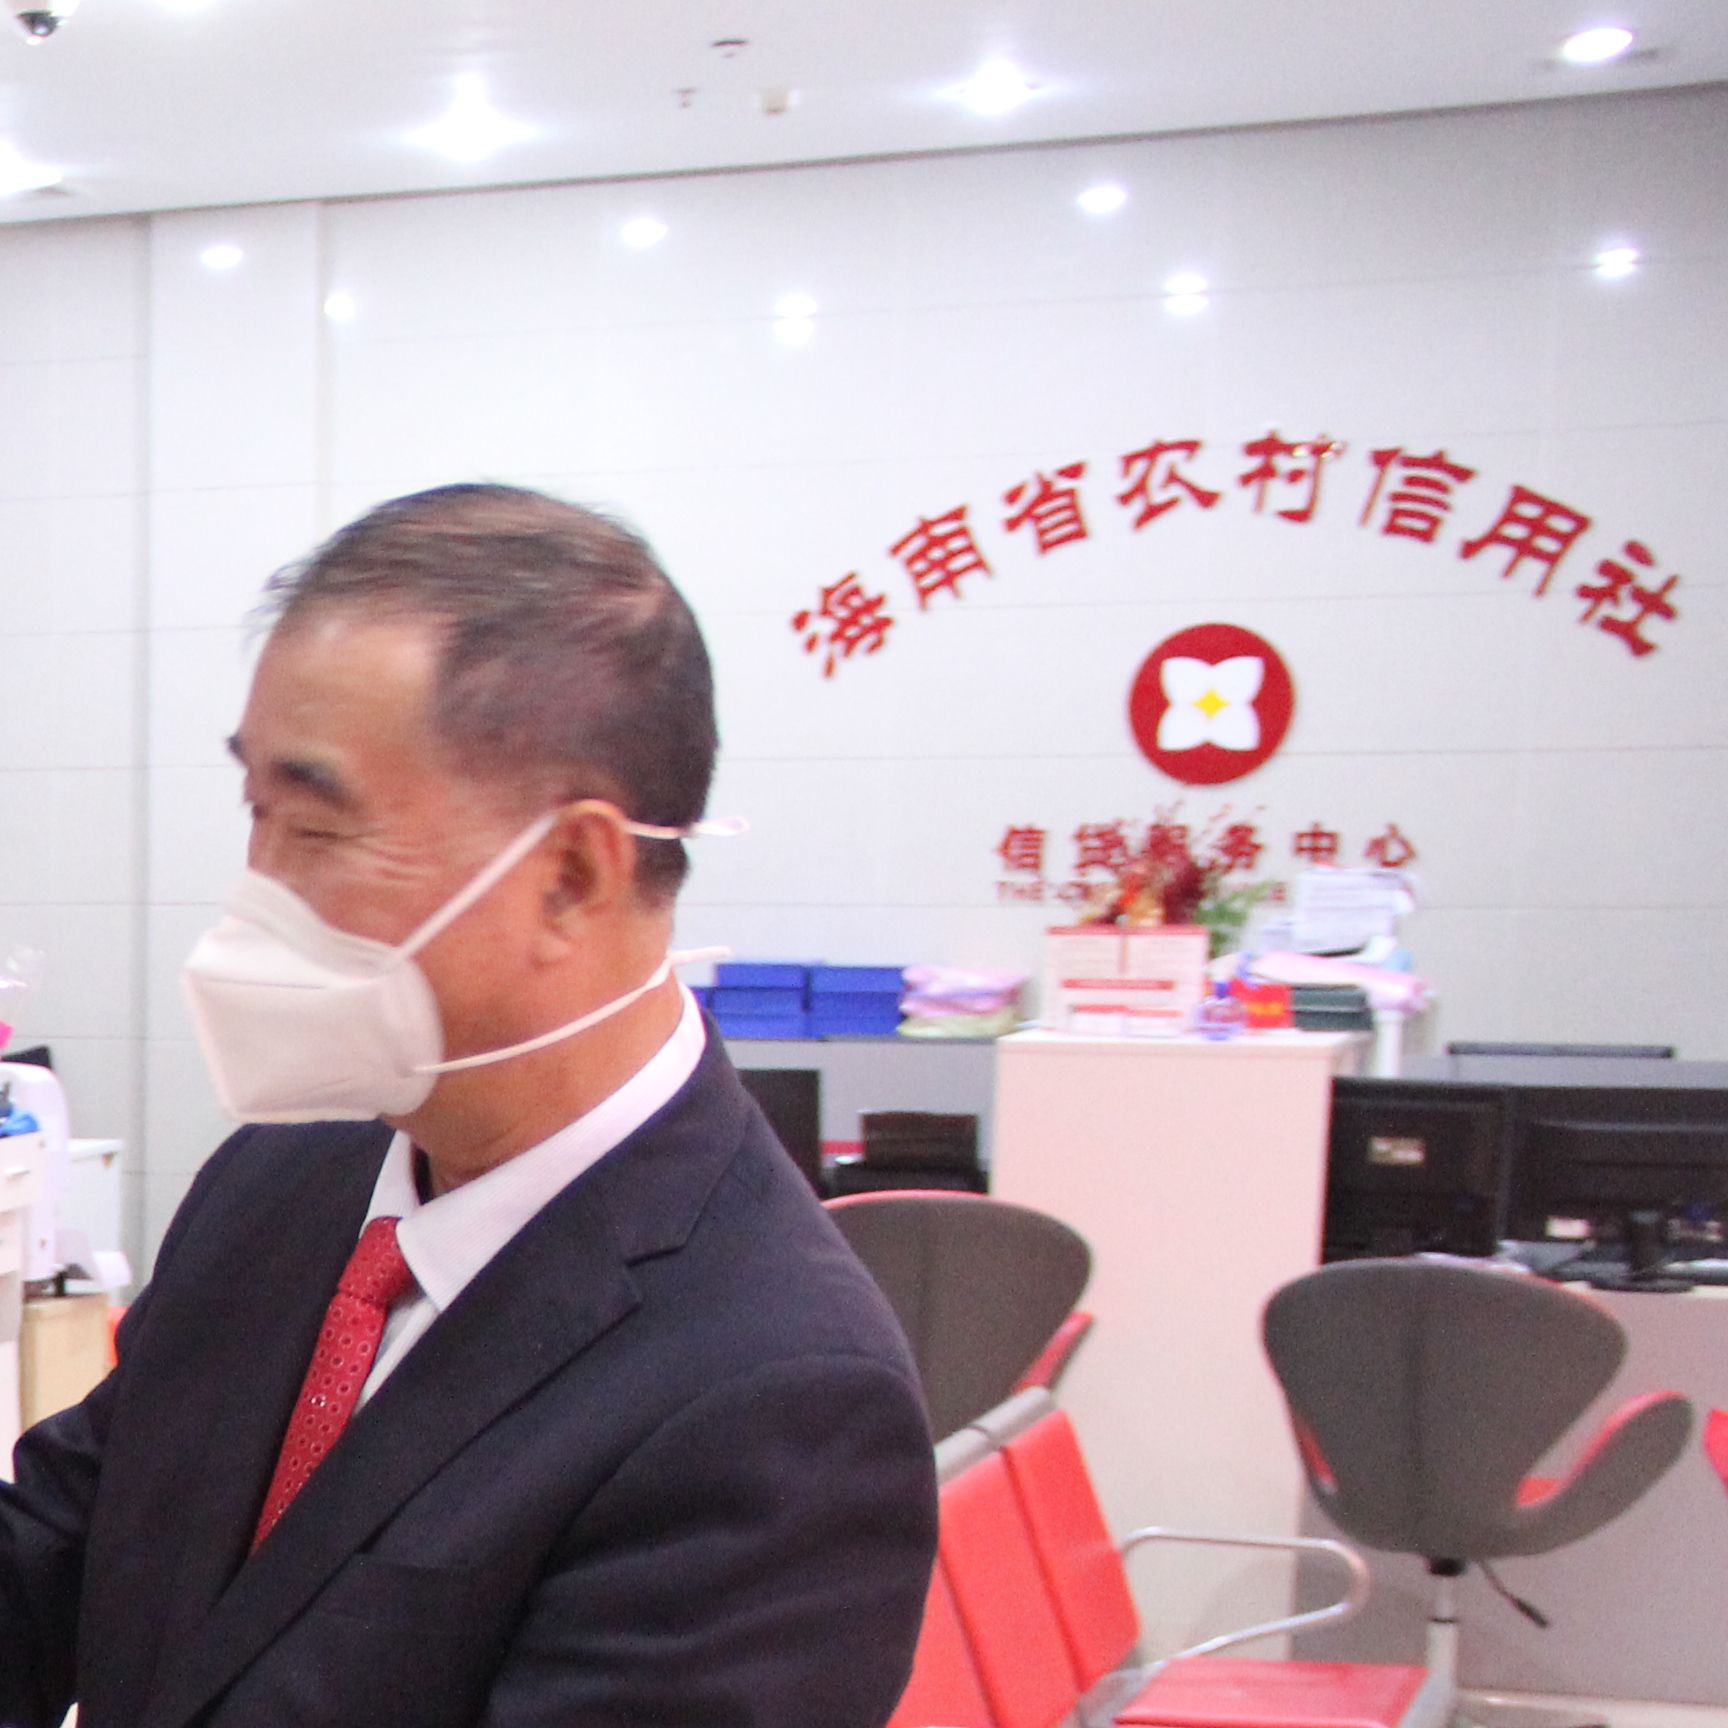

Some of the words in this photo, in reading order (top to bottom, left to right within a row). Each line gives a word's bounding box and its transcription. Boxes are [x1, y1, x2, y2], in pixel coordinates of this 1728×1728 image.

[791, 429, 1684, 680] 海南省农村信用社
